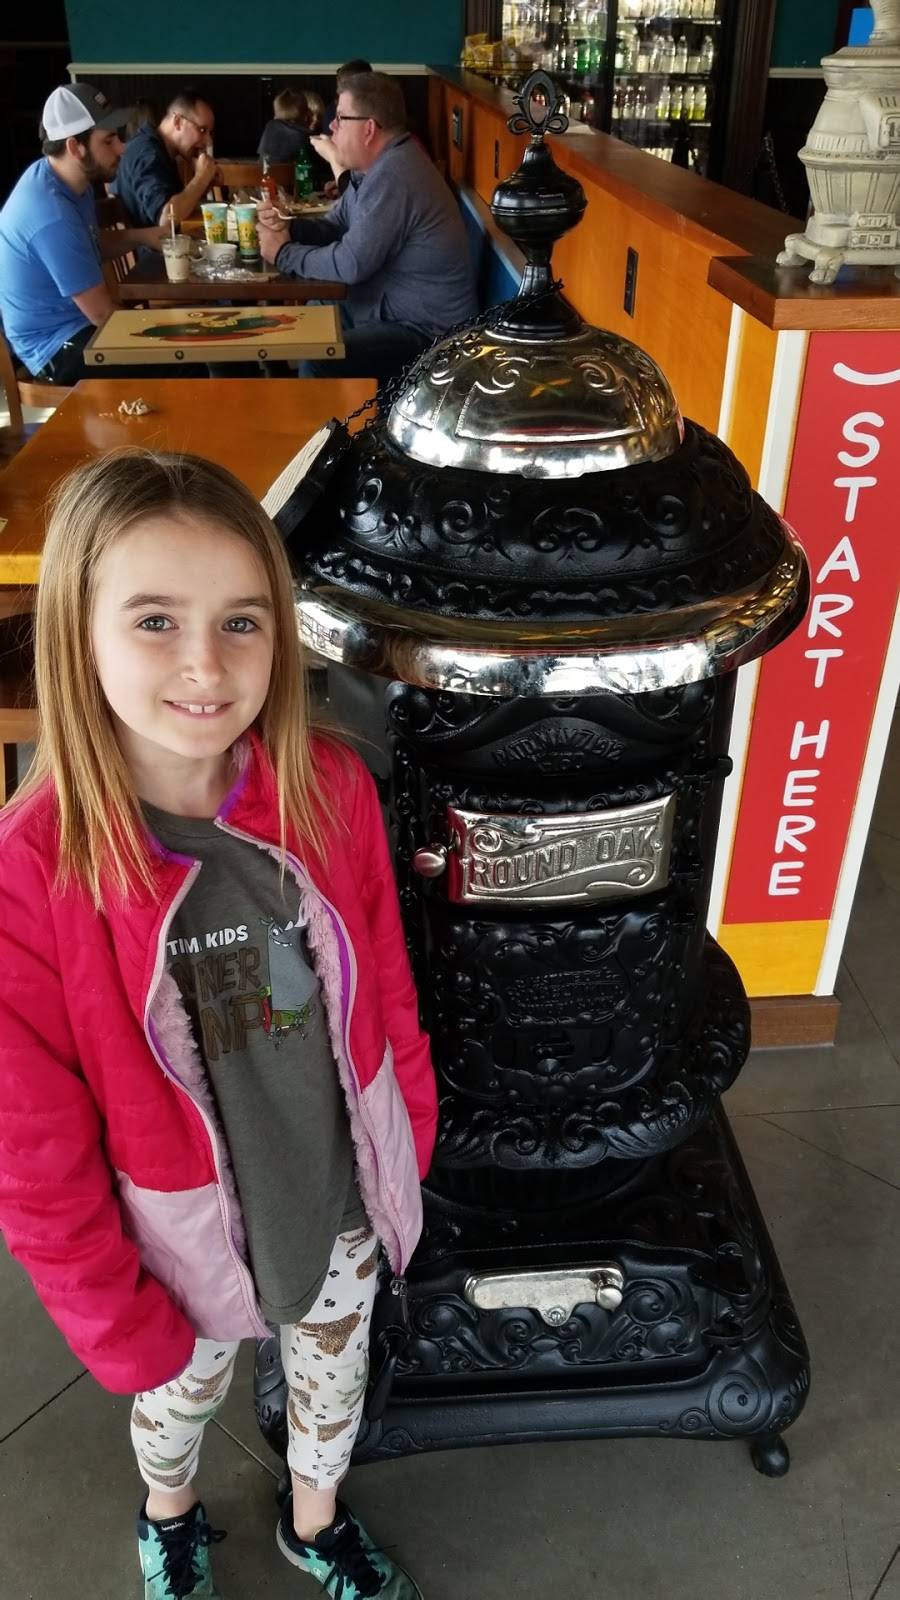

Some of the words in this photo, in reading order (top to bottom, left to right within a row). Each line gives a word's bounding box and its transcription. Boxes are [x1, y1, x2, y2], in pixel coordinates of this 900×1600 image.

[804, 411, 885, 689] START
[472, 840, 577, 888] ROUND
[596, 825, 657, 862] OAK
[767, 719, 830, 896] HERE
[205, 924, 249, 949] KIDS
